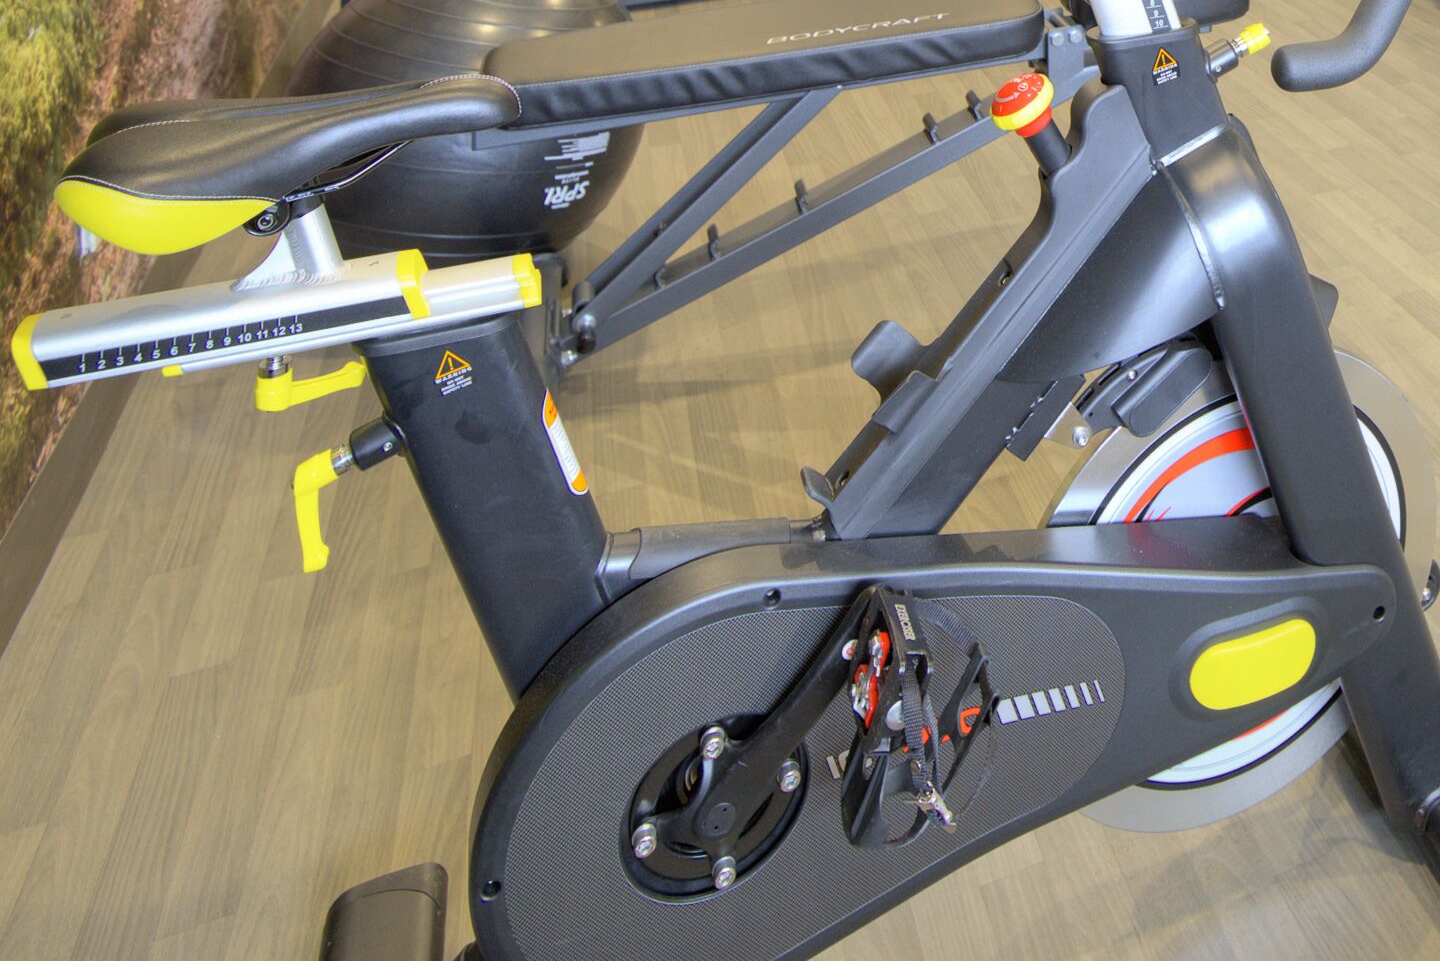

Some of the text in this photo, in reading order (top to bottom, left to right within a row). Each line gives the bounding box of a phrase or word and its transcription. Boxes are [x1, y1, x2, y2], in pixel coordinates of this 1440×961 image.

[766, 12, 949, 45] BODYCRAFT
[79, 324, 303, 373] 1 2 3 4 5 6 7 8 9 10 11 12 13
